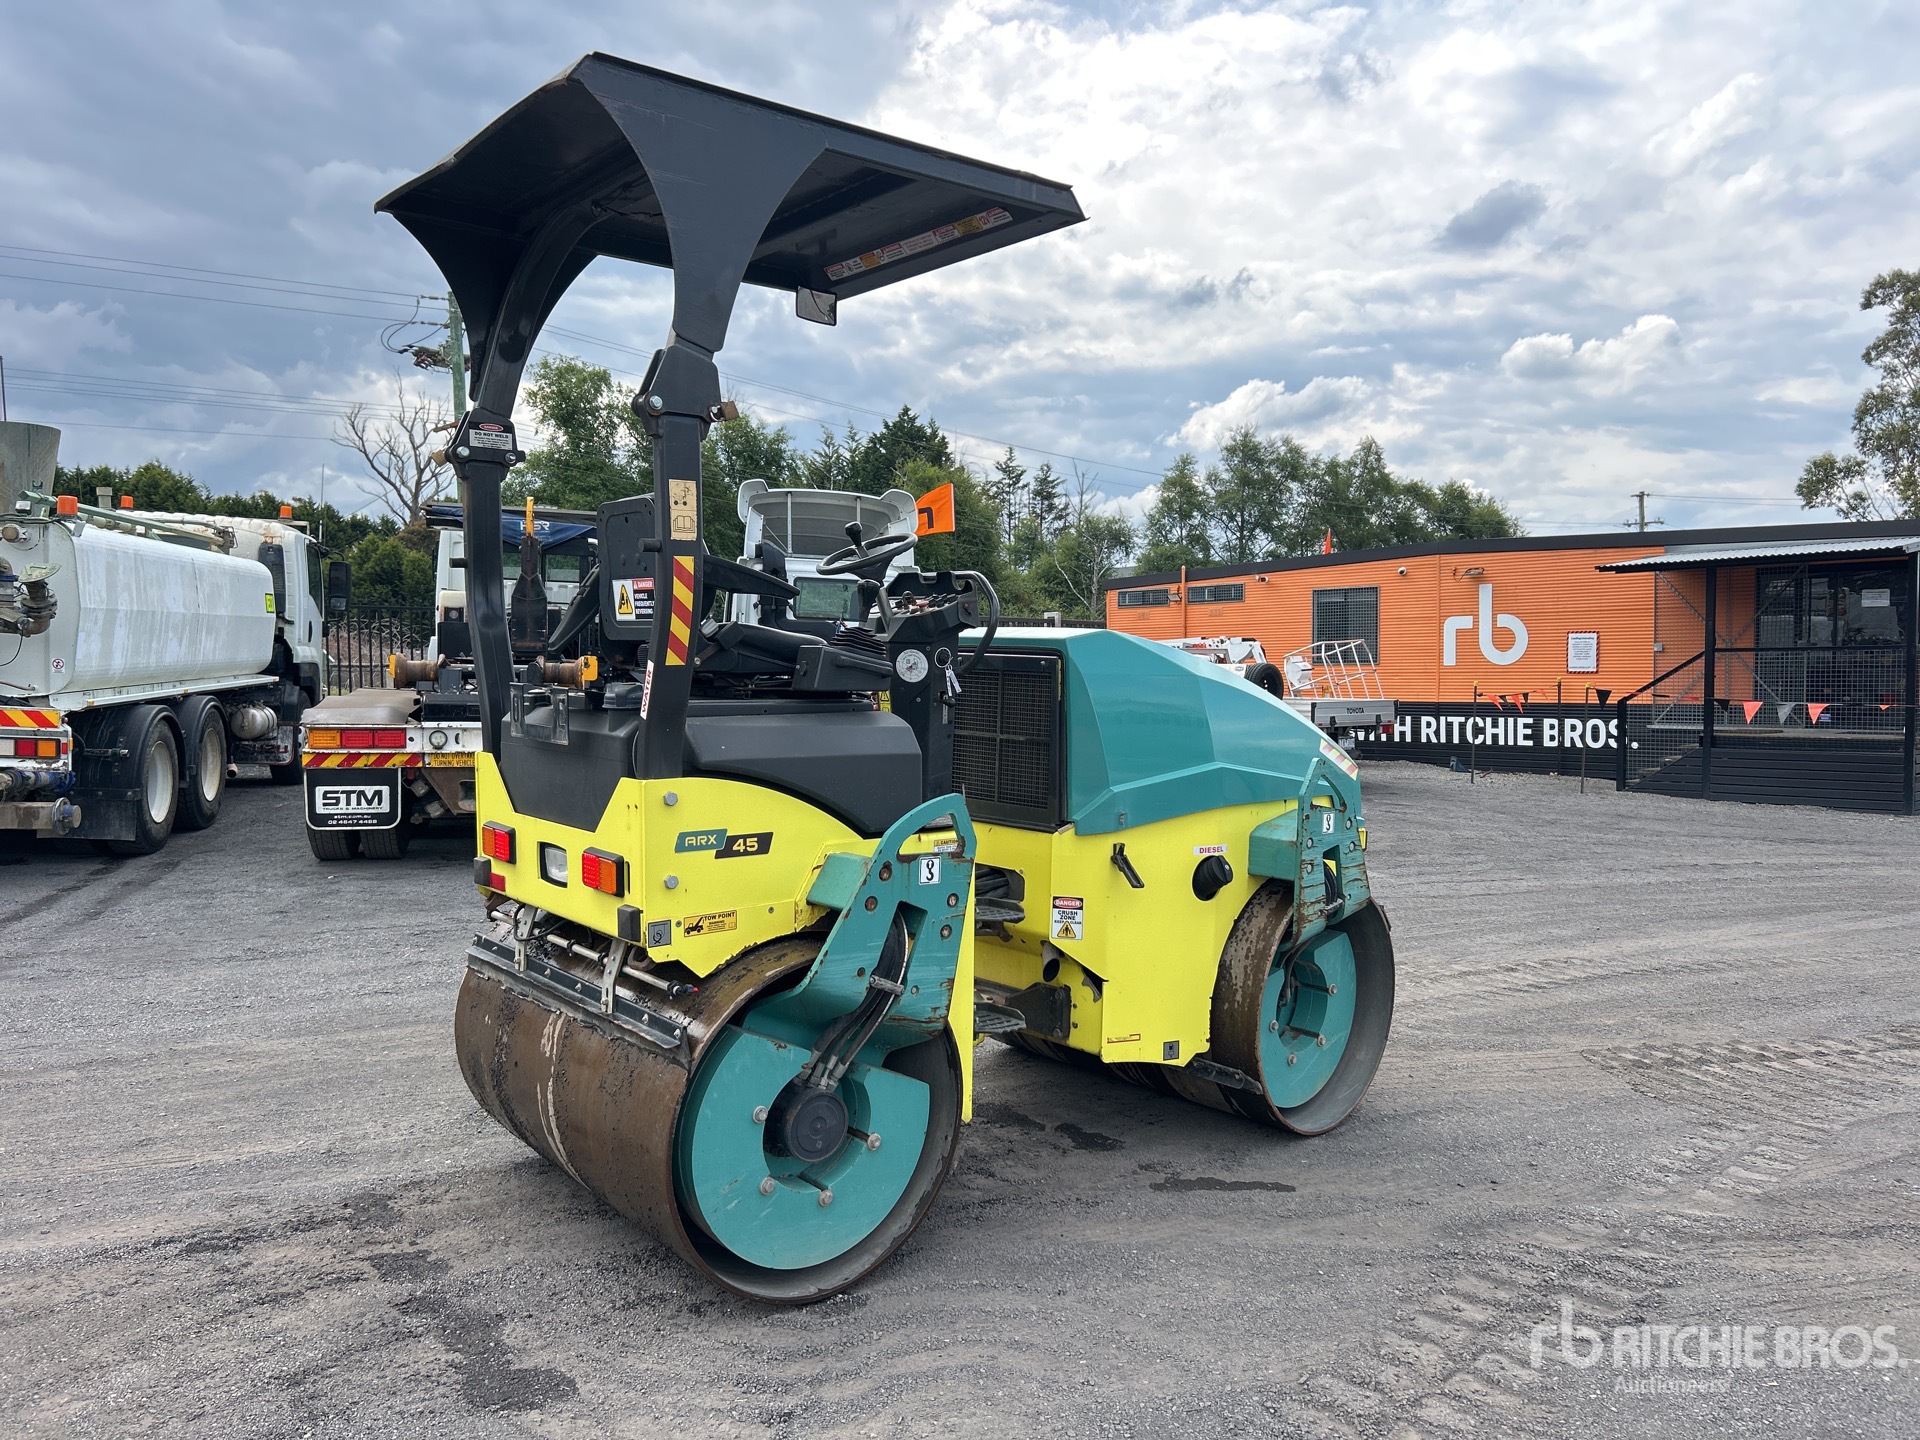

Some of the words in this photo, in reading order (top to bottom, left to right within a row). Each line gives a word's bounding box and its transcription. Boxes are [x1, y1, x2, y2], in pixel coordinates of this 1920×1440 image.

[1443, 584, 1528, 666] rb
[642, 670, 652, 712] WATER
[1420, 716, 1534, 746] RITCHIE
[322, 790, 383, 806] STM
[684, 834, 717, 846] ARX
[732, 838, 758, 852] 45
